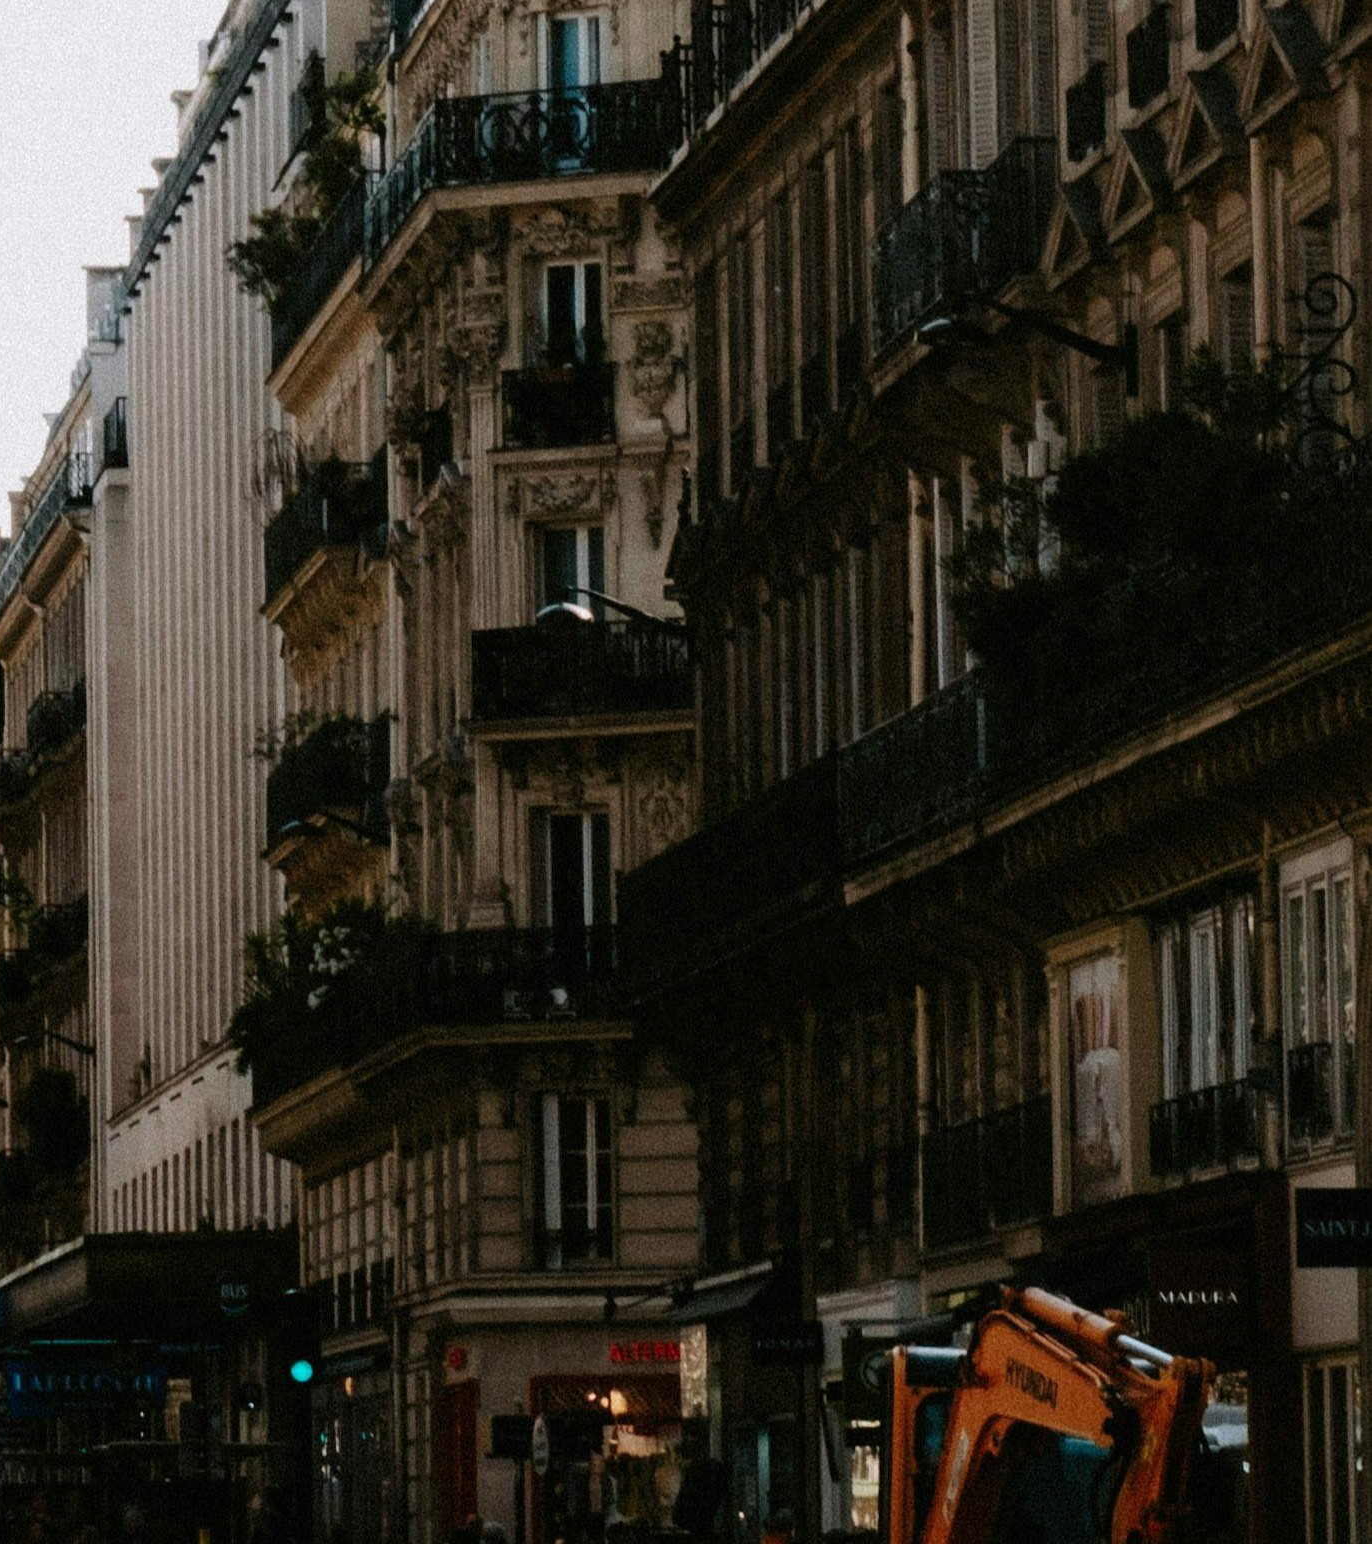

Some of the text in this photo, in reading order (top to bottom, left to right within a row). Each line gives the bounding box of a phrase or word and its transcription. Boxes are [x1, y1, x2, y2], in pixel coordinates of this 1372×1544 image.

[1304, 1219, 1359, 1237] SAINT
[1159, 1290, 1239, 1305] MADURA
[1005, 1357, 1059, 1409] HYUNDAI
